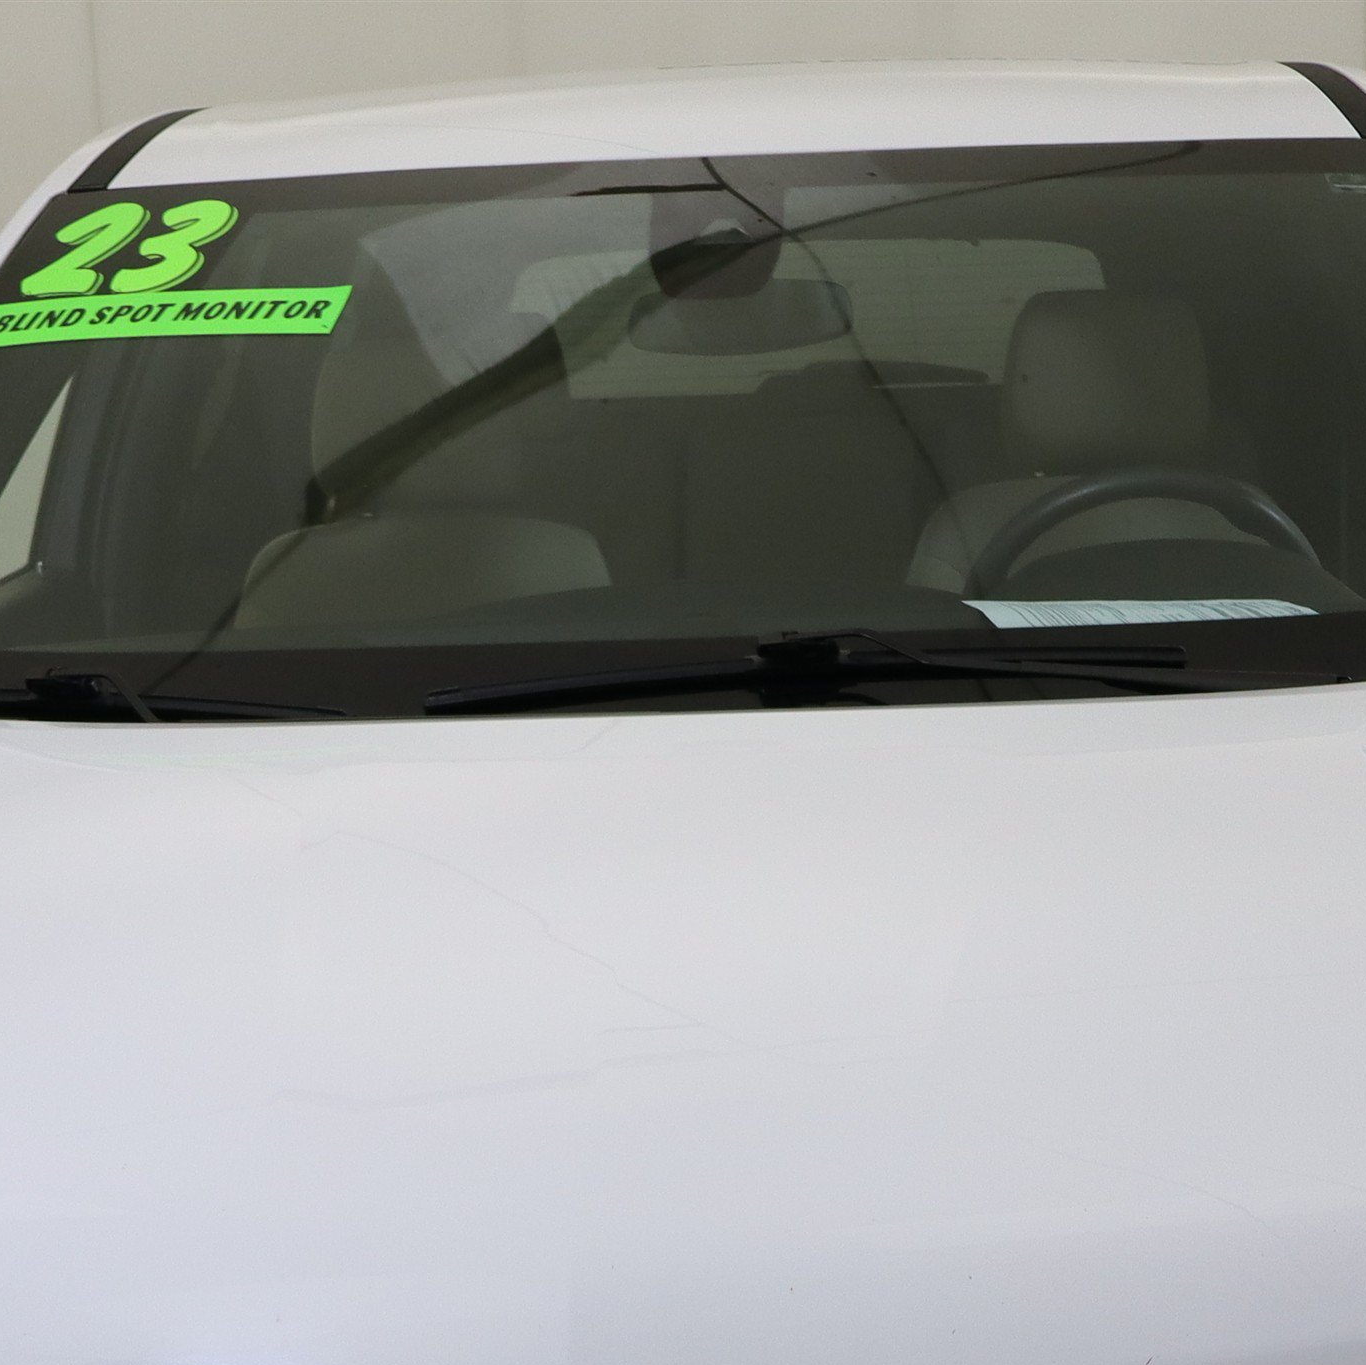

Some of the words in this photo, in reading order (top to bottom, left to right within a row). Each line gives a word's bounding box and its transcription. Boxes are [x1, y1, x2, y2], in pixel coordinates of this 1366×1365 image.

[20, 198, 239, 298] 23
[88, 302, 176, 325] SPOT
[173, 299, 332, 322] MONITOR
